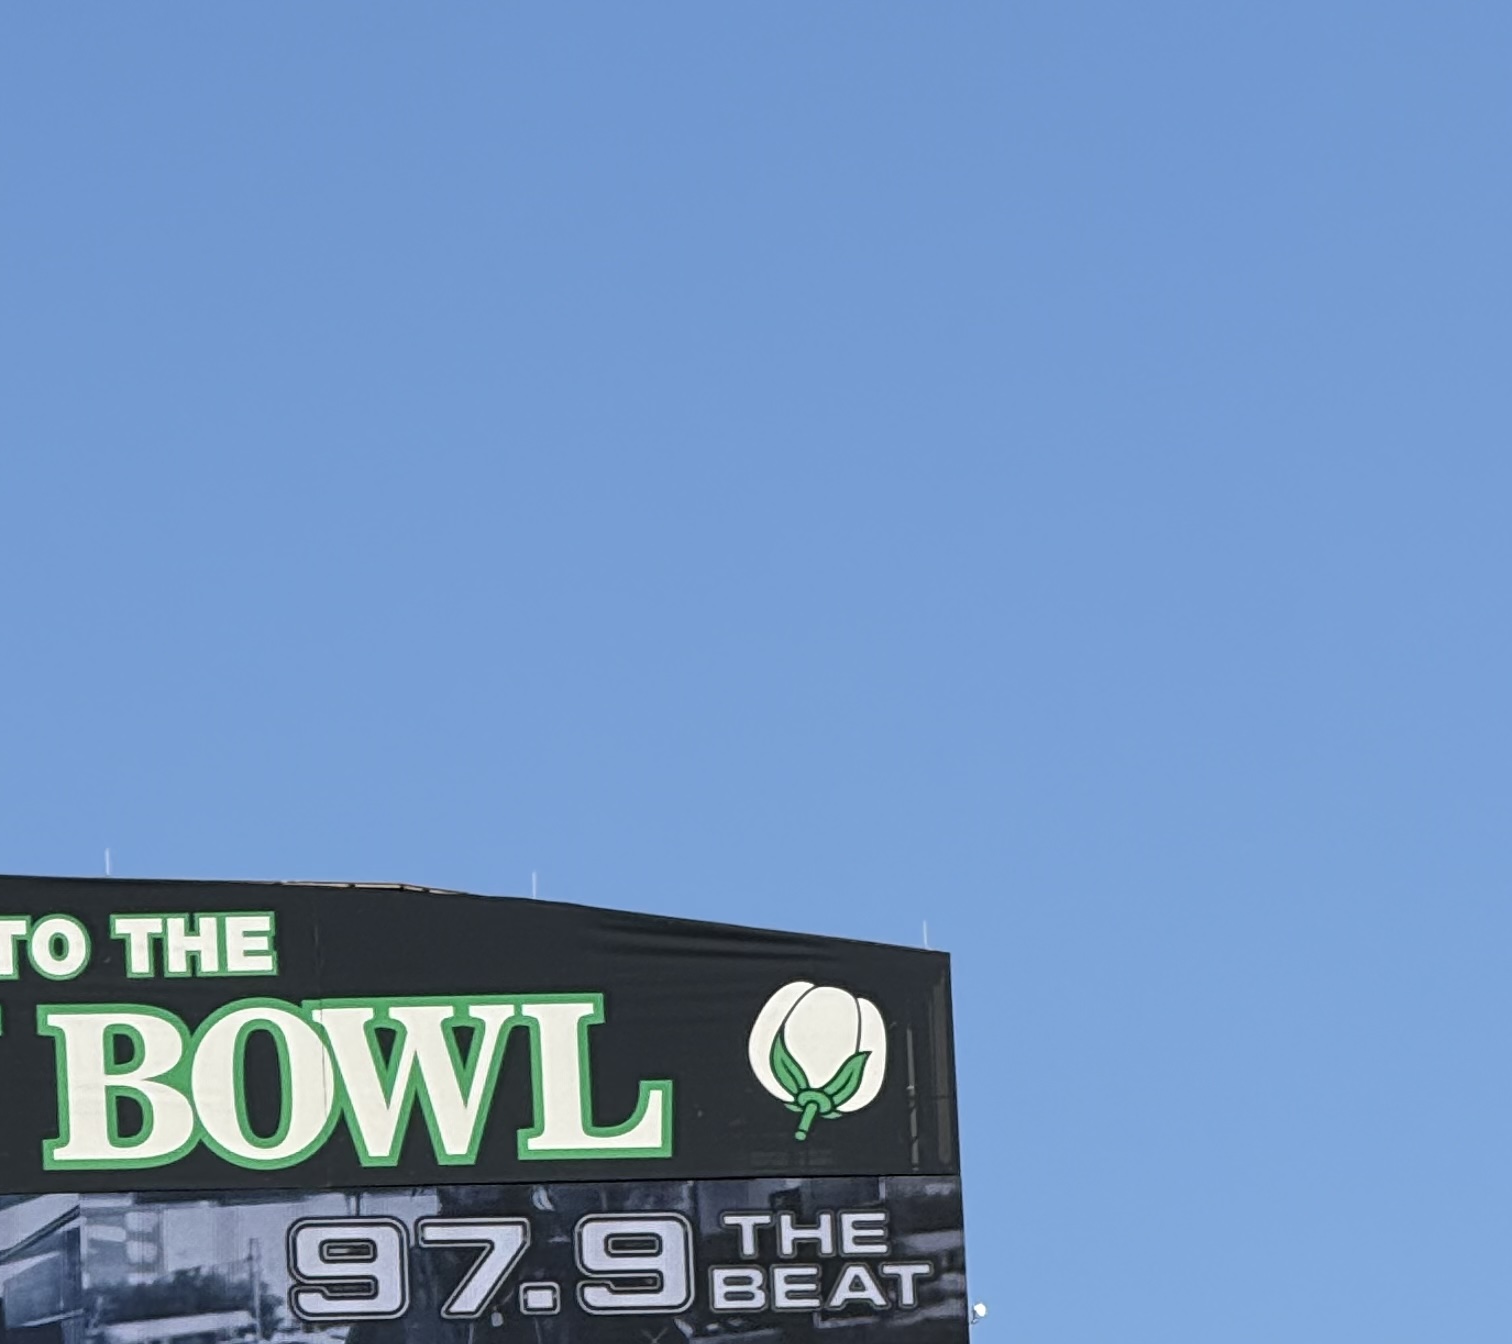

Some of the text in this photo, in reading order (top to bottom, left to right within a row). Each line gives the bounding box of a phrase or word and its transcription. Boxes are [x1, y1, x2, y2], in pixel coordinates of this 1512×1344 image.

[111, 910, 277, 979] THE
[38, 993, 672, 1171] BOWL
[289, 1210, 694, 1321] 97.9
[722, 1209, 888, 1258] THE
[708, 1260, 932, 1313] BEAT
